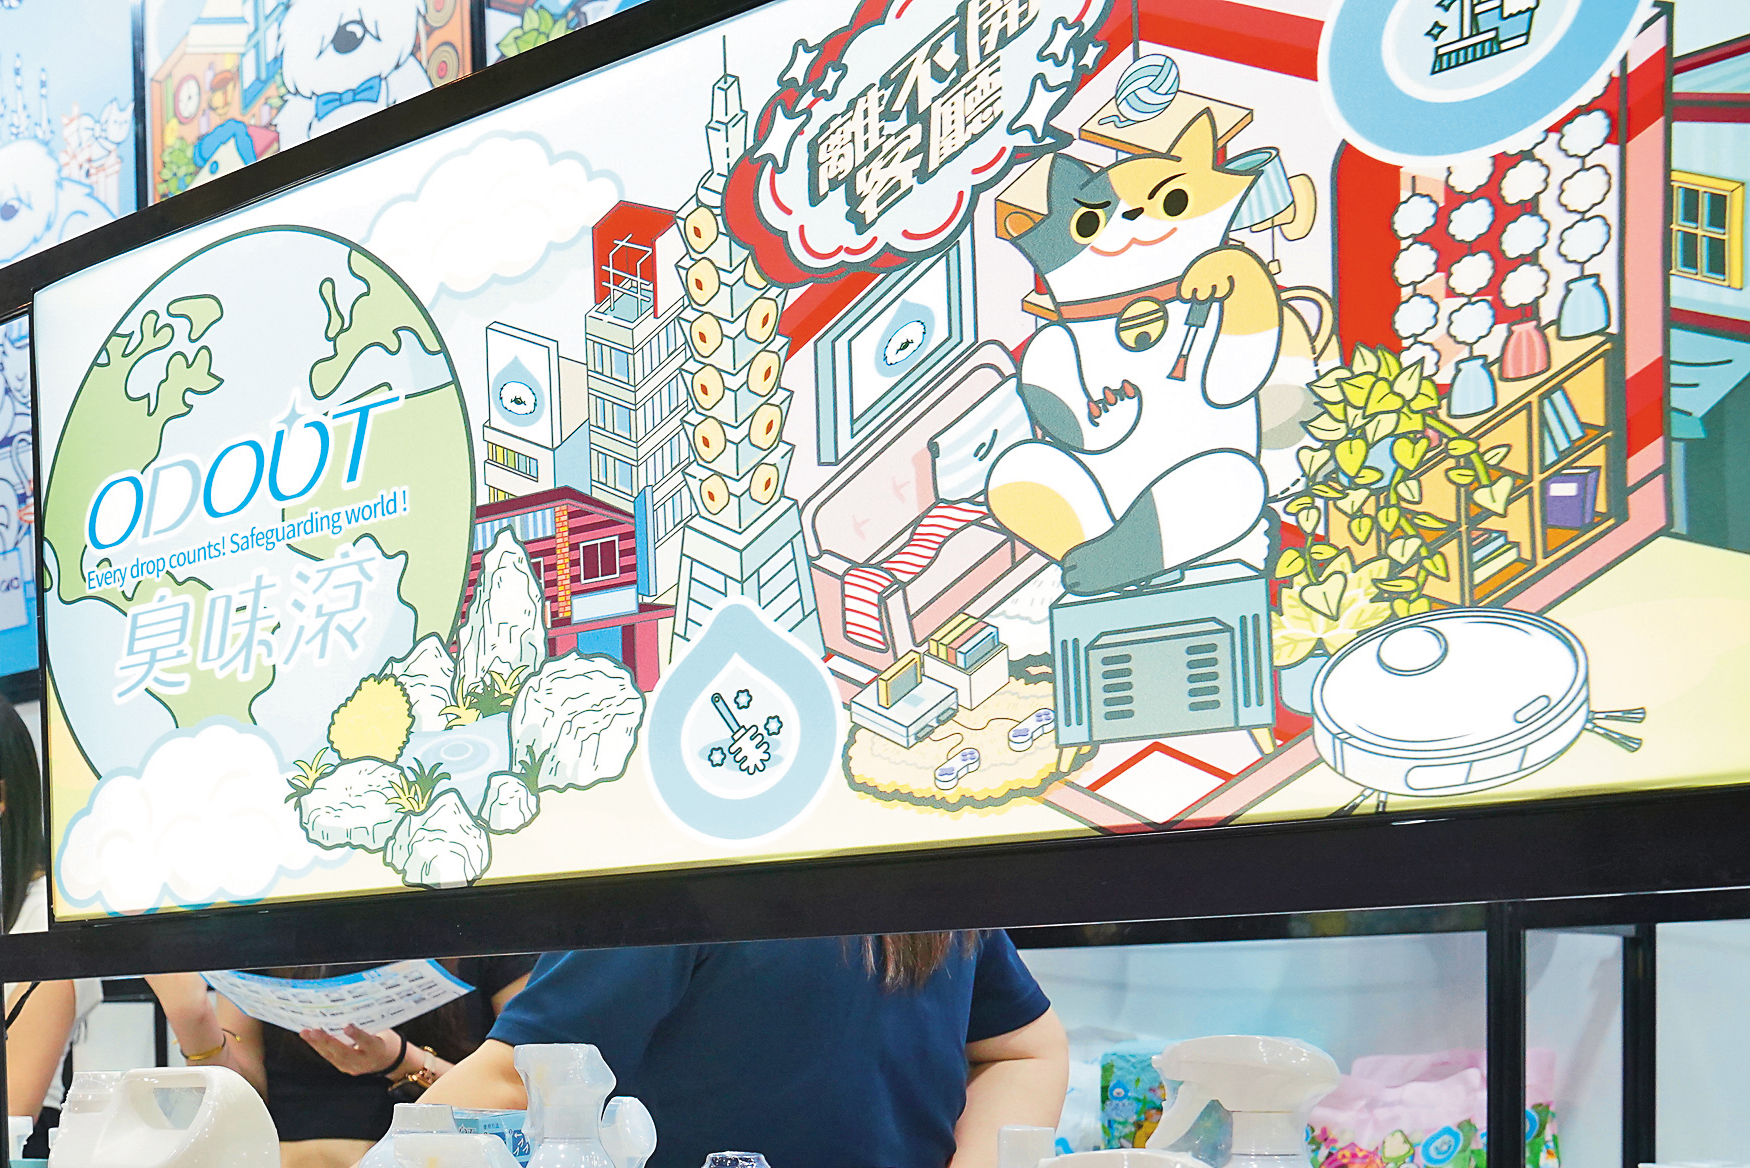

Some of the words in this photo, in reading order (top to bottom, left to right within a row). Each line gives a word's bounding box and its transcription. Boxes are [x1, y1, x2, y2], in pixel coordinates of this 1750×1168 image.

[88, 396, 400, 551] ODOUT
[86, 567, 128, 592] Every
[130, 555, 167, 580] drop
[168, 536, 226, 568] counts!
[230, 509, 343, 553] Safeguarding
[116, 551, 378, 698] 臭味滾
